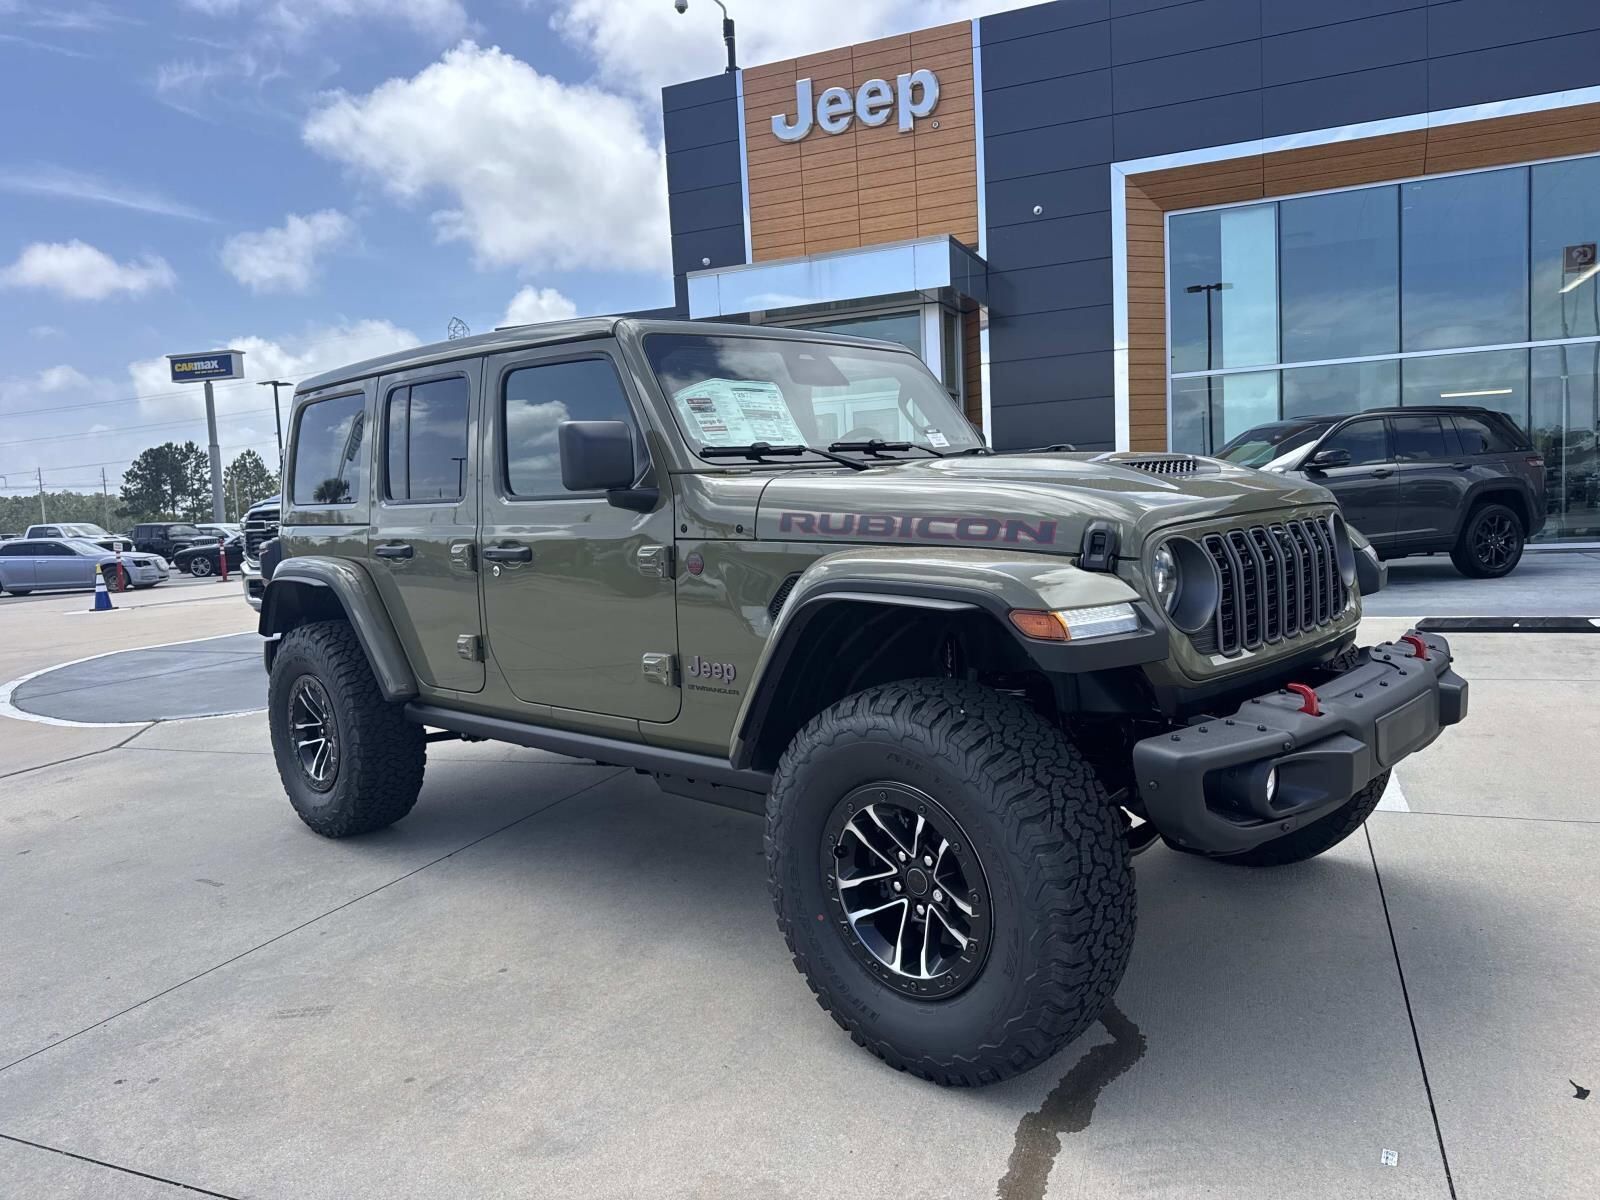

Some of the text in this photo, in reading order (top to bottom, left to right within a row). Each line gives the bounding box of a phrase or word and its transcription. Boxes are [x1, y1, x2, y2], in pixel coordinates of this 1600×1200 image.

[771, 68, 940, 143] Jeep
[779, 511, 1058, 545] RUBICON
[687, 655, 737, 685] Jeep
